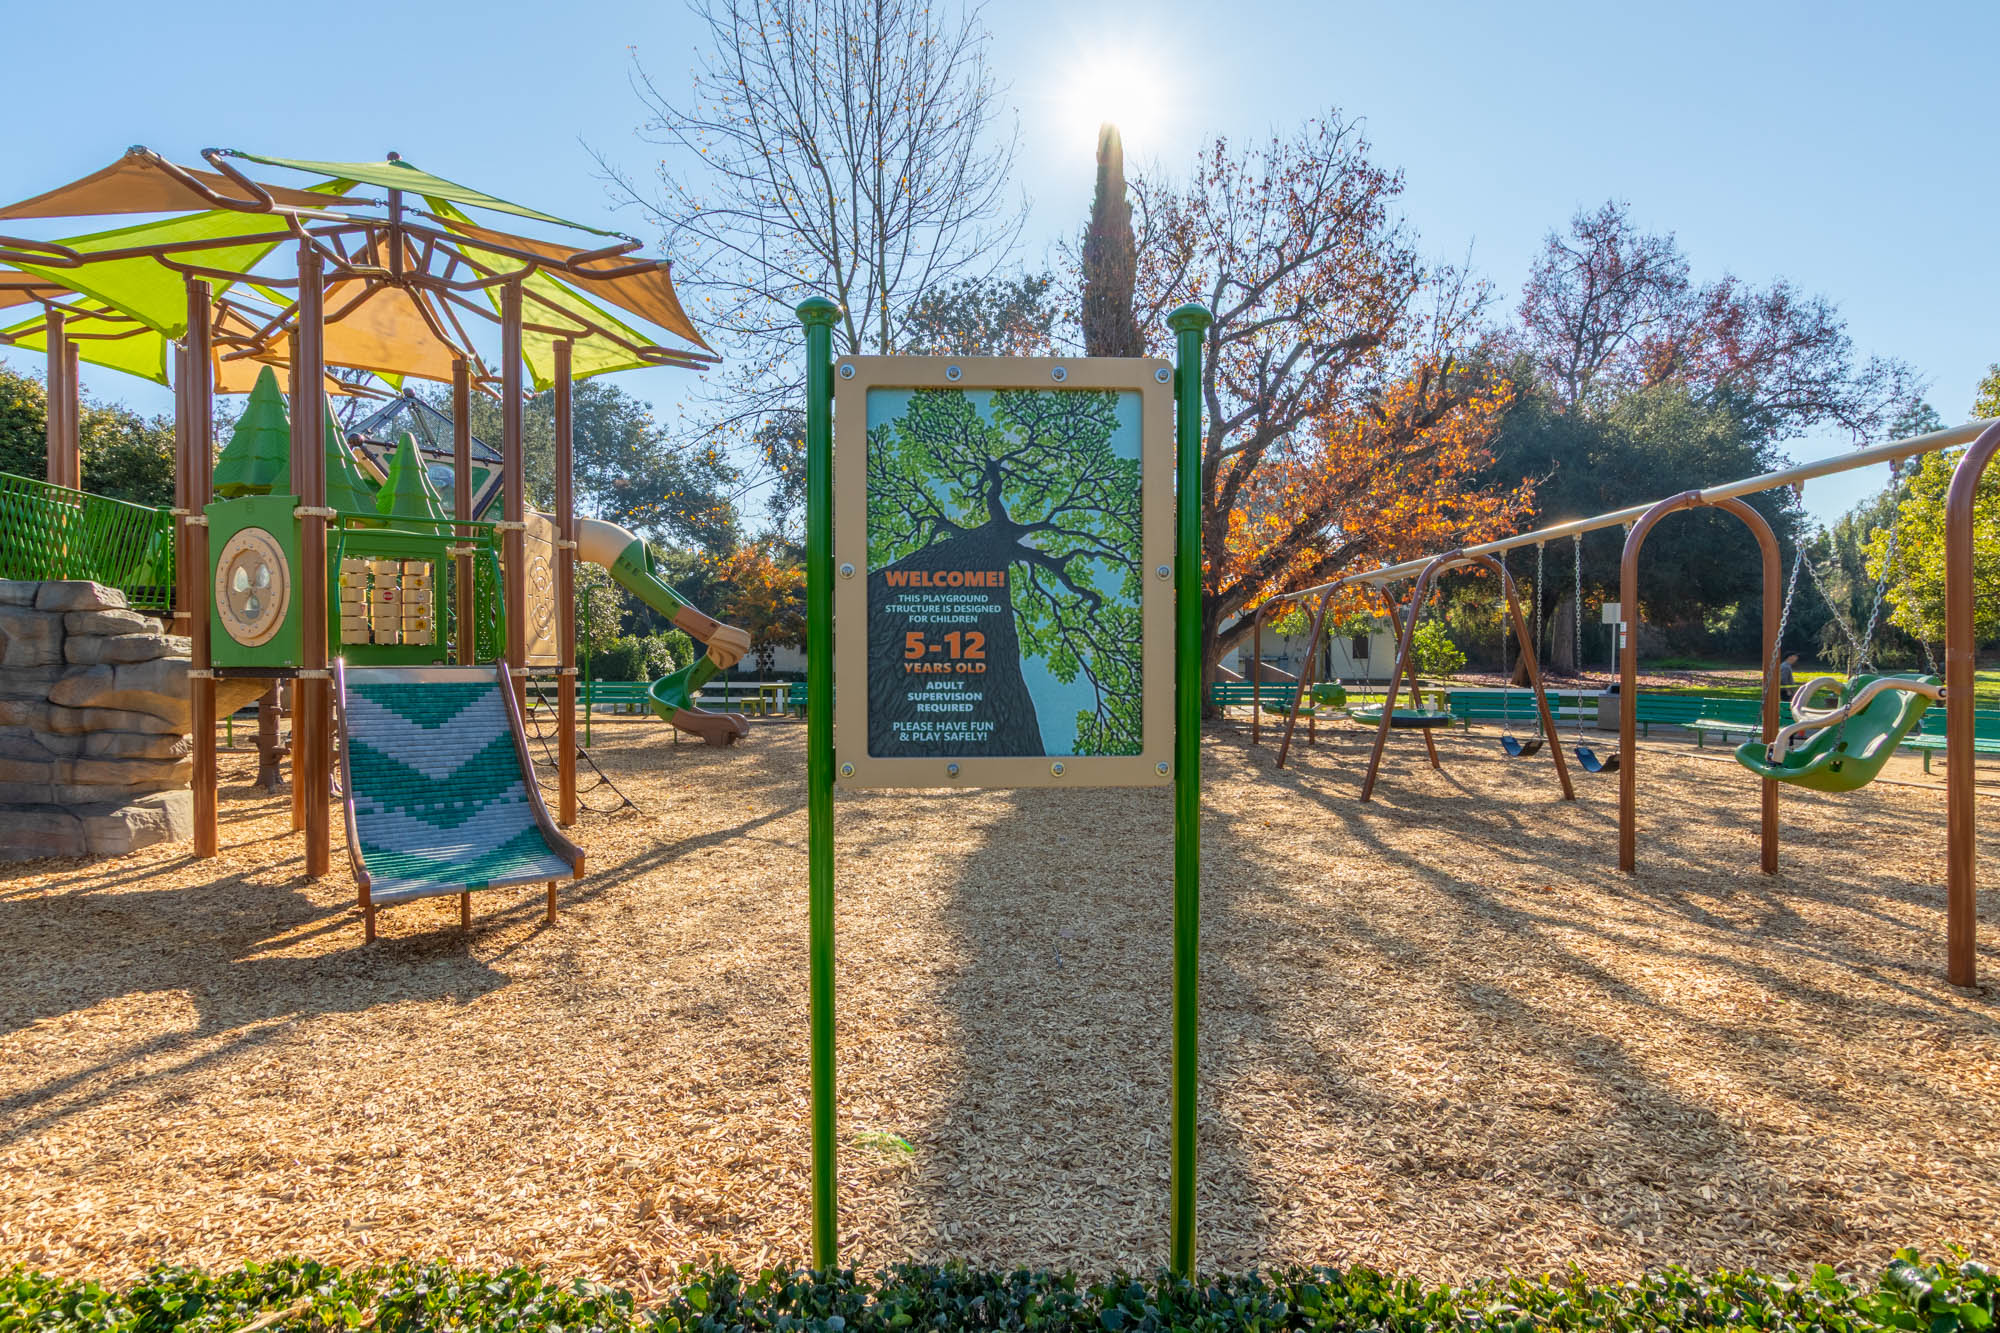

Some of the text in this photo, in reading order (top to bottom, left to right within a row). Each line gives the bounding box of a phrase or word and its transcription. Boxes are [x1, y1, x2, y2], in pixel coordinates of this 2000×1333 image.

[885, 571, 1005, 587] WELCOME!
[898, 594, 989, 603] THIS PLAYGROUND
[885, 604, 1001, 613] STRUCTURE IS DESIGNED
[908, 615, 978, 623] FOR CHILDREN
[904, 631, 985, 659] 5-12
[904, 662, 986, 673] YEARS OLD
[926, 681, 965, 690] ADULT
[907, 692, 983, 701] SUPERVISION
[917, 703, 974, 712] REQUIRED
[893, 721, 995, 731] PLEASE HAVE FUN
[899, 731, 988, 741] & PLAY SAFELY!
